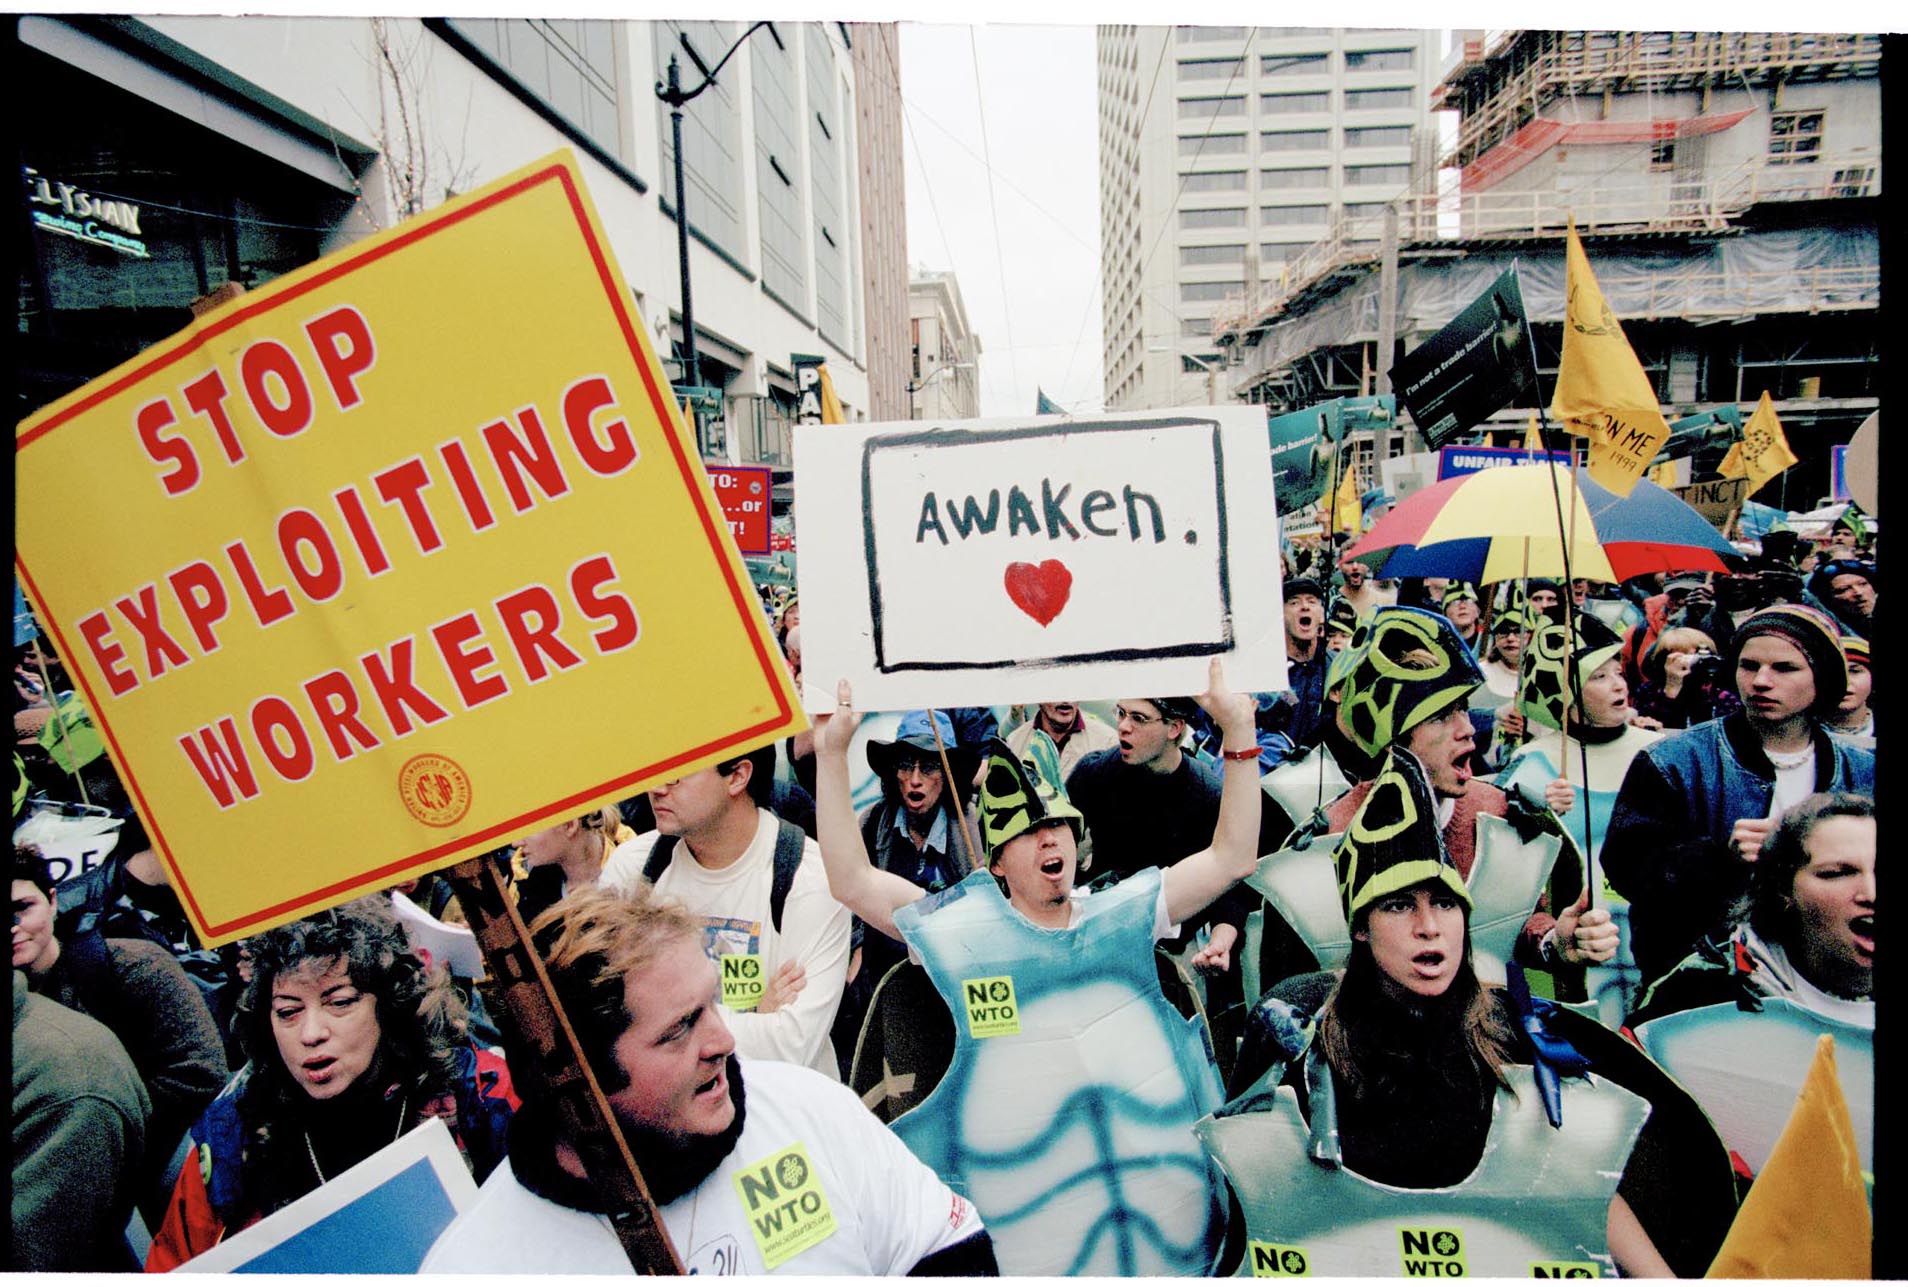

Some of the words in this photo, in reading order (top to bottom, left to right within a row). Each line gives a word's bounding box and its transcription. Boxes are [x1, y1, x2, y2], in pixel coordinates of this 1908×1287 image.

[1405, 383, 1419, 397] I'm
[1419, 371, 1434, 386] not
[1434, 367, 1441, 377] a
[1440, 349, 1466, 371] trade
[1465, 320, 1497, 353] barrier!
[133, 304, 377, 498] STOP
[1621, 427, 1655, 458] ME
[1609, 450, 1638, 473] 1999
[76, 374, 640, 697] EXPLOITING
[176, 553, 641, 811] WORKERS
[724, 958, 760, 979] NO
[723, 981, 763, 996] WTO
[967, 981, 1010, 1005] NO
[970, 1005, 1014, 1022] WTO
[740, 1153, 808, 1211] NO
[754, 1190, 822, 1239] WTO
[1403, 1230, 1460, 1256] NO
[1254, 1246, 1306, 1274] NO
[1404, 1259, 1463, 1277] WTO
